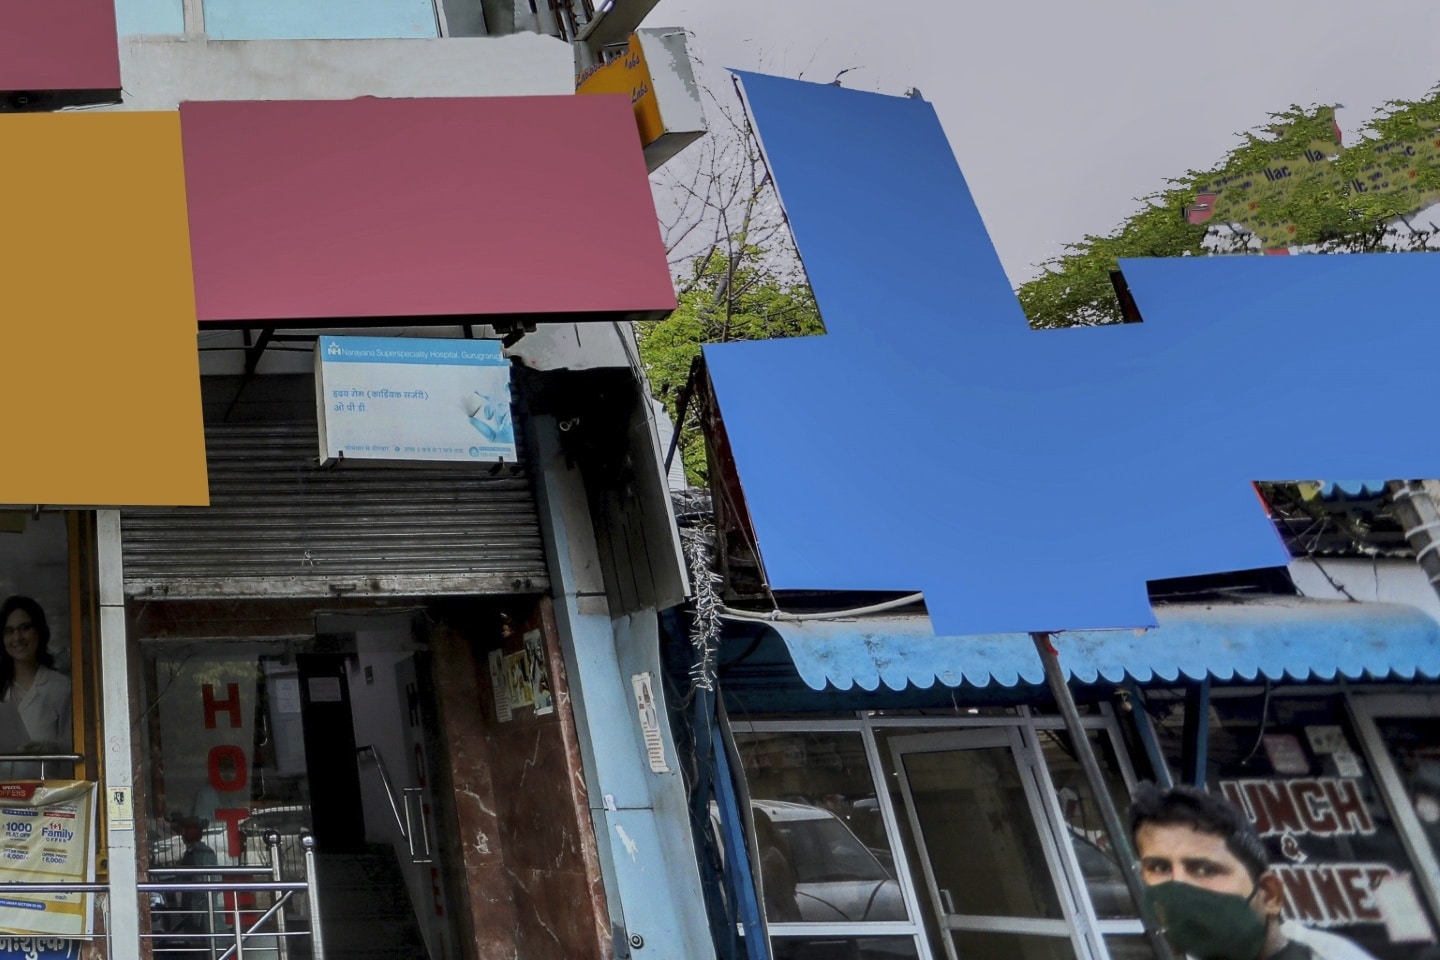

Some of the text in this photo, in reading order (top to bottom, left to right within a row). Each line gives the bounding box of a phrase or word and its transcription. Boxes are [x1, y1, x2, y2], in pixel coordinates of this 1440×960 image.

[342, 349, 376, 357] Narayana
[376, 349, 428, 360] Superspeciality
[1206, 777, 1376, 836] UNCH
[49, 822, 62, 830] 1+1
[202, 683, 262, 960] HOTE
[41, 827, 74, 841] Family
